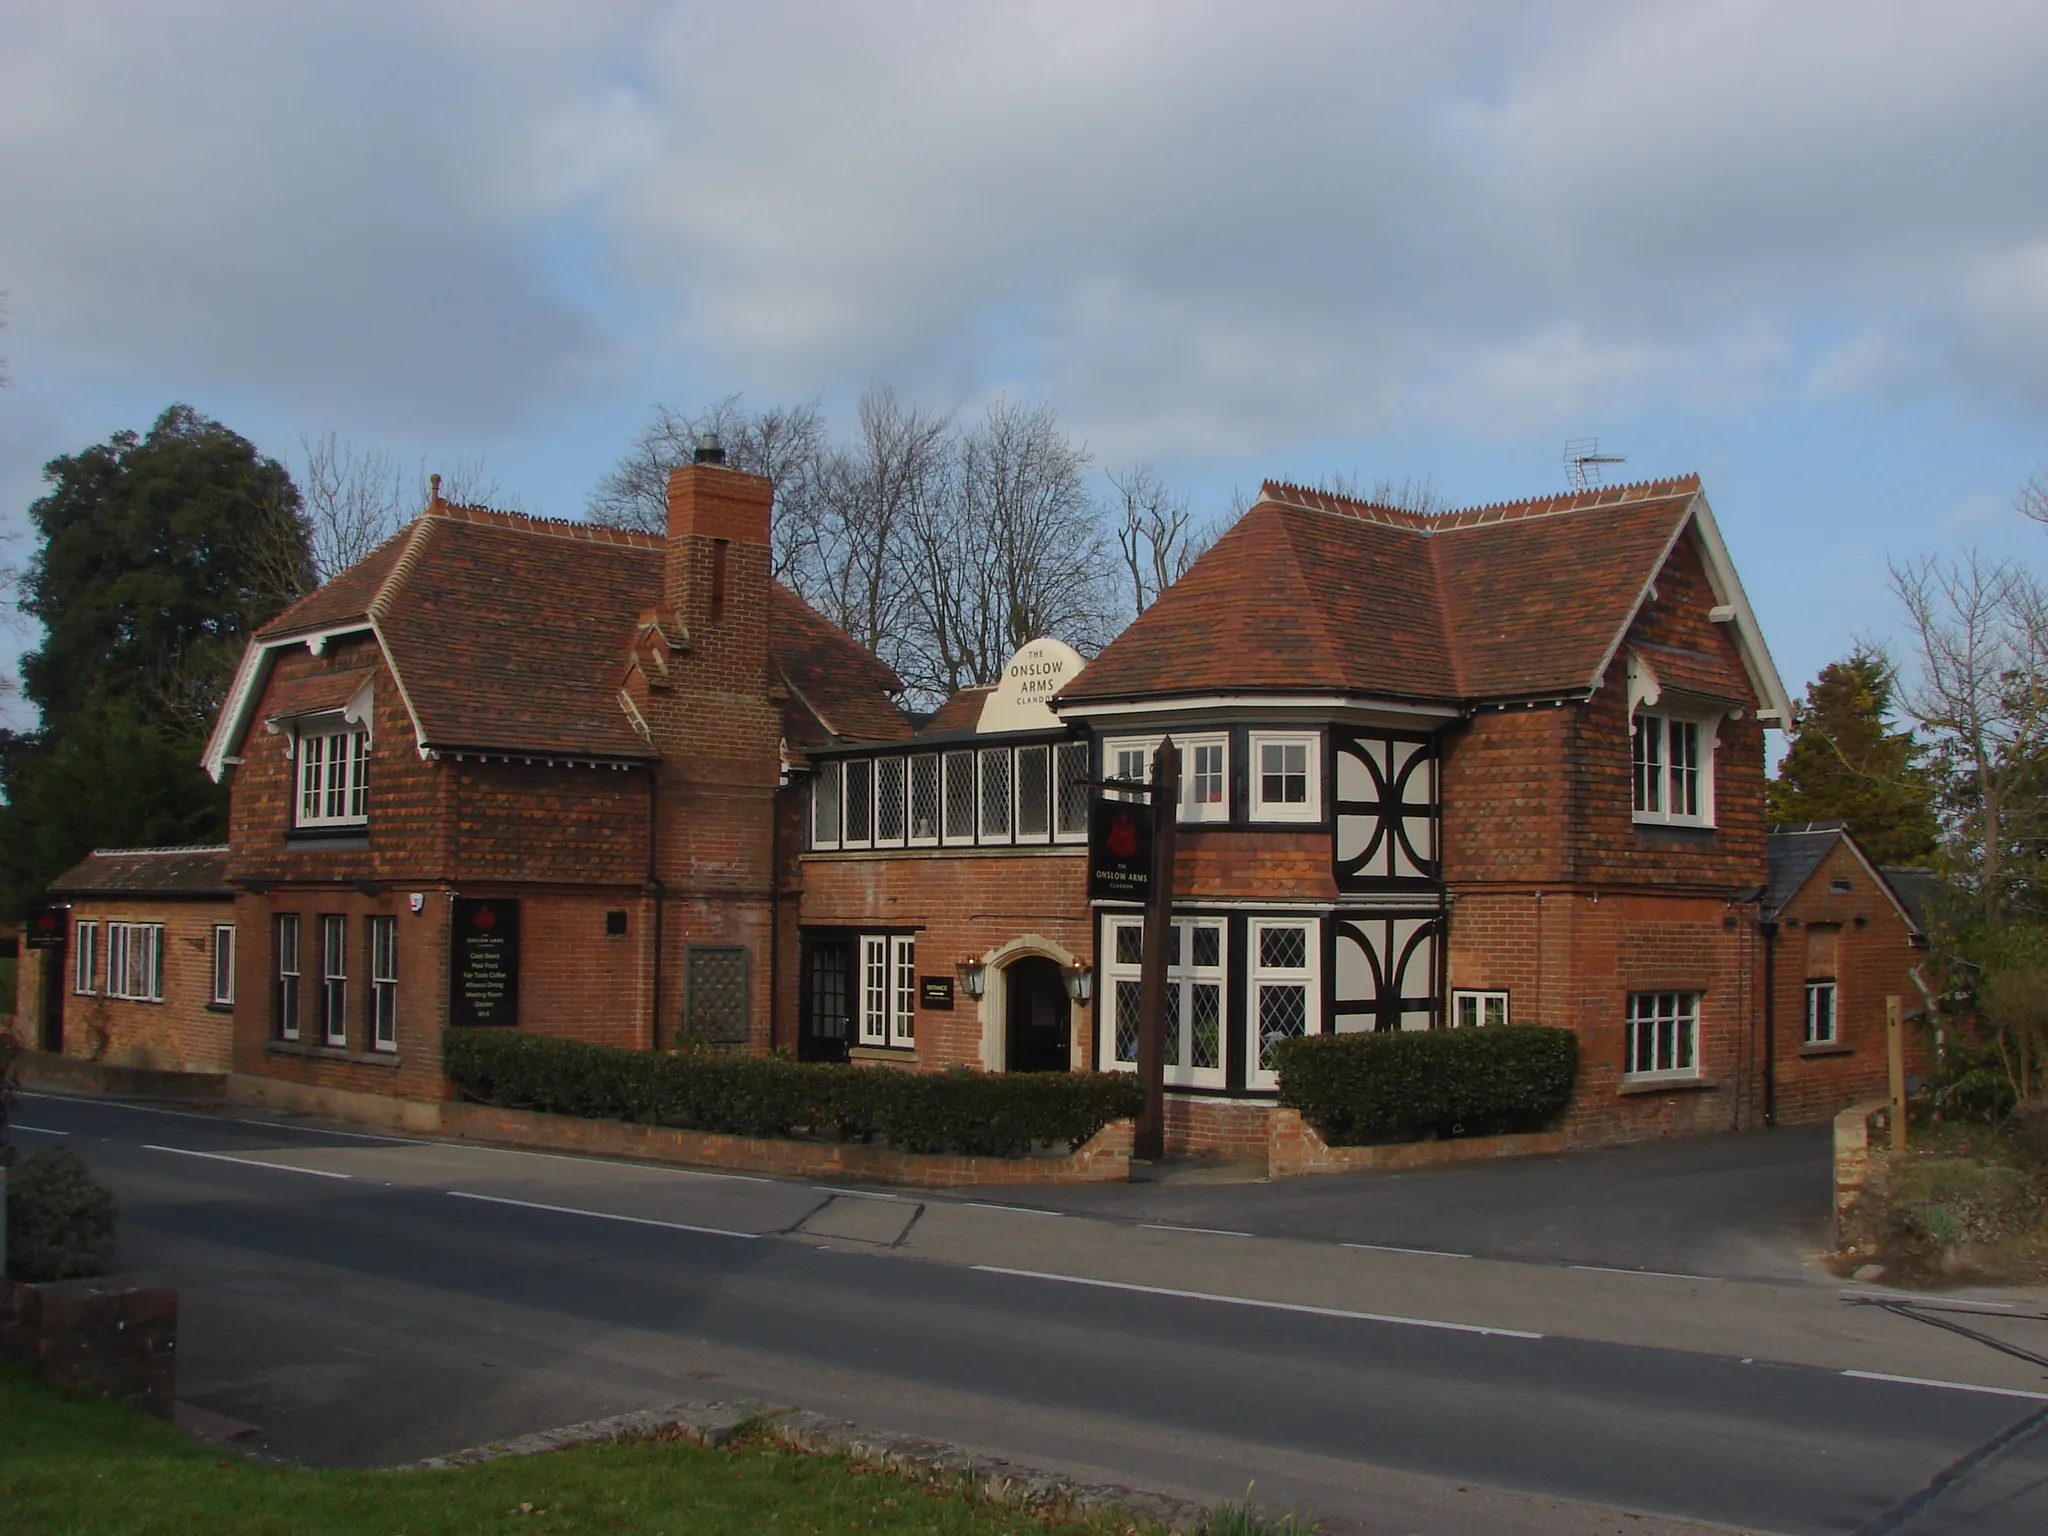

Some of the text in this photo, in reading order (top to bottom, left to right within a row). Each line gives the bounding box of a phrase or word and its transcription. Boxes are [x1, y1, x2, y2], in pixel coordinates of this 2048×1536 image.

[1028, 650, 1043, 658] THE
[1011, 661, 1063, 677] ONSLOW
[1021, 679, 1054, 693] ARMS
[1017, 695, 1052, 704] CLANDO
[1096, 870, 1147, 882] ONSLOW ARMS
